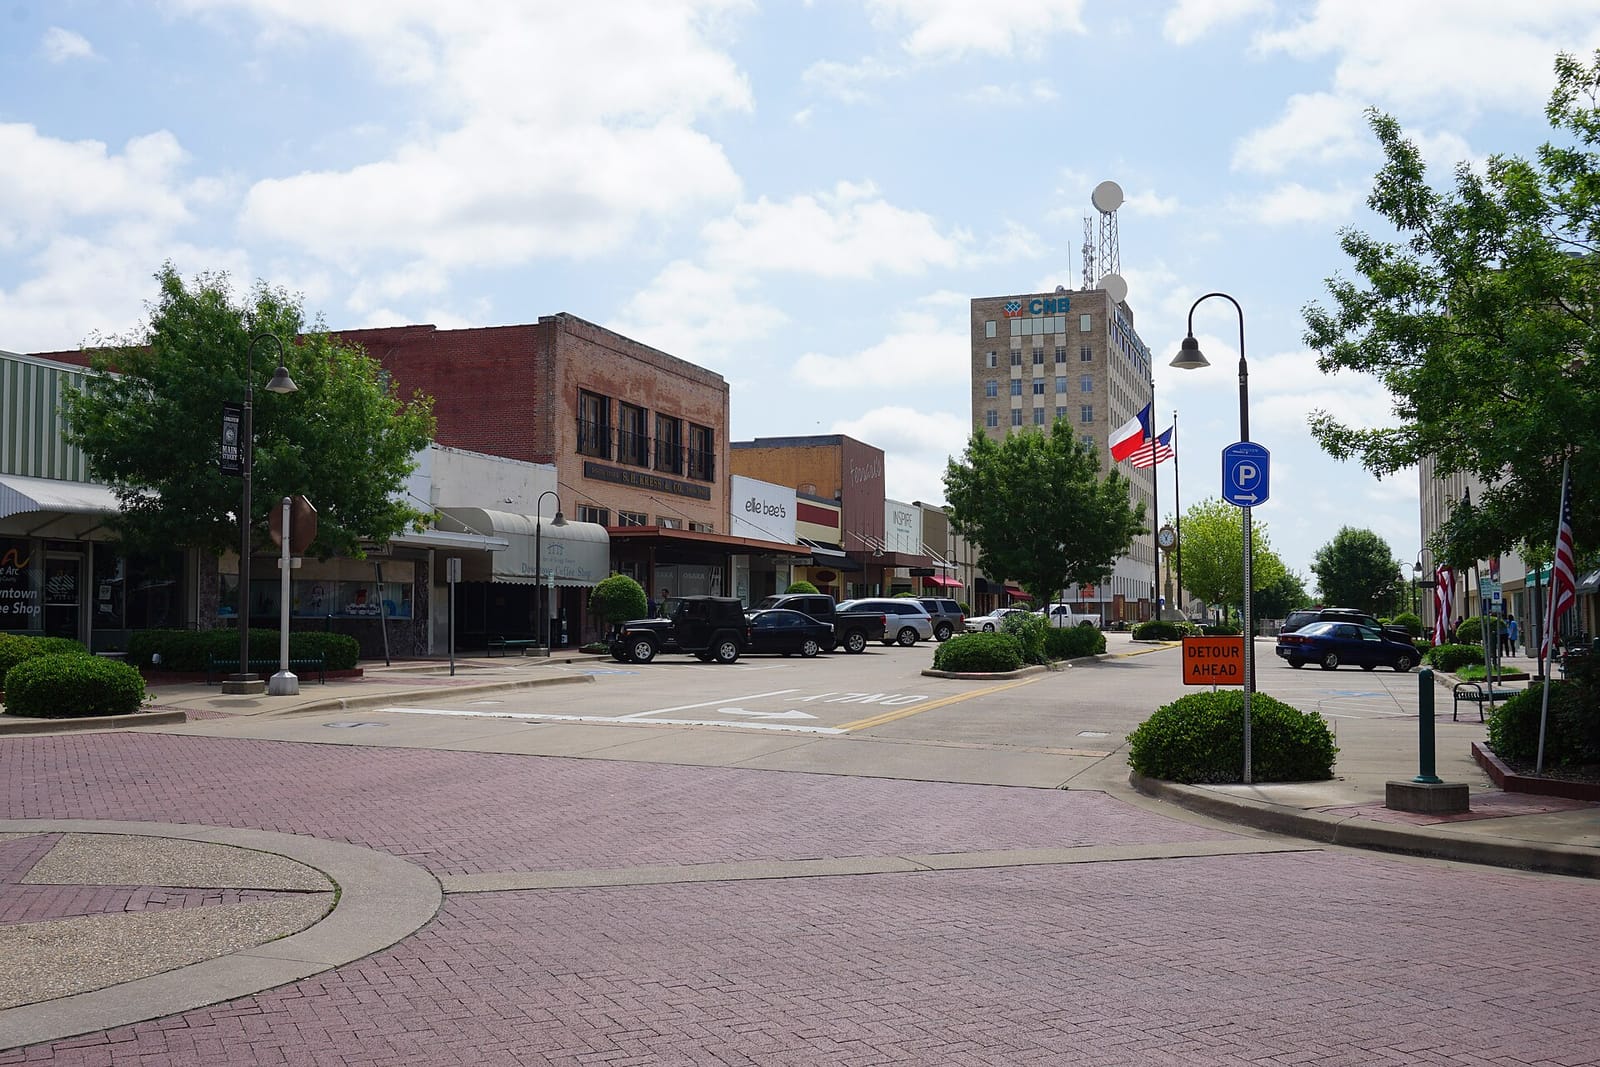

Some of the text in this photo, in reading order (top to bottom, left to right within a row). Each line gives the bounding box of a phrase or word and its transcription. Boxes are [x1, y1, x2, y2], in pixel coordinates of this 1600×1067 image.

[1029, 297, 1071, 315] CNB
[222, 445, 237, 454] MAIN
[640, 474, 661, 489] KRESS
[1240, 465, 1256, 486] P
[763, 499, 786, 518] bee's
[0, 587, 38, 599] ntown
[12, 602, 41, 616] Shop
[1188, 646, 1240, 658] DETOUR
[1192, 663, 1237, 676] AHEAD
